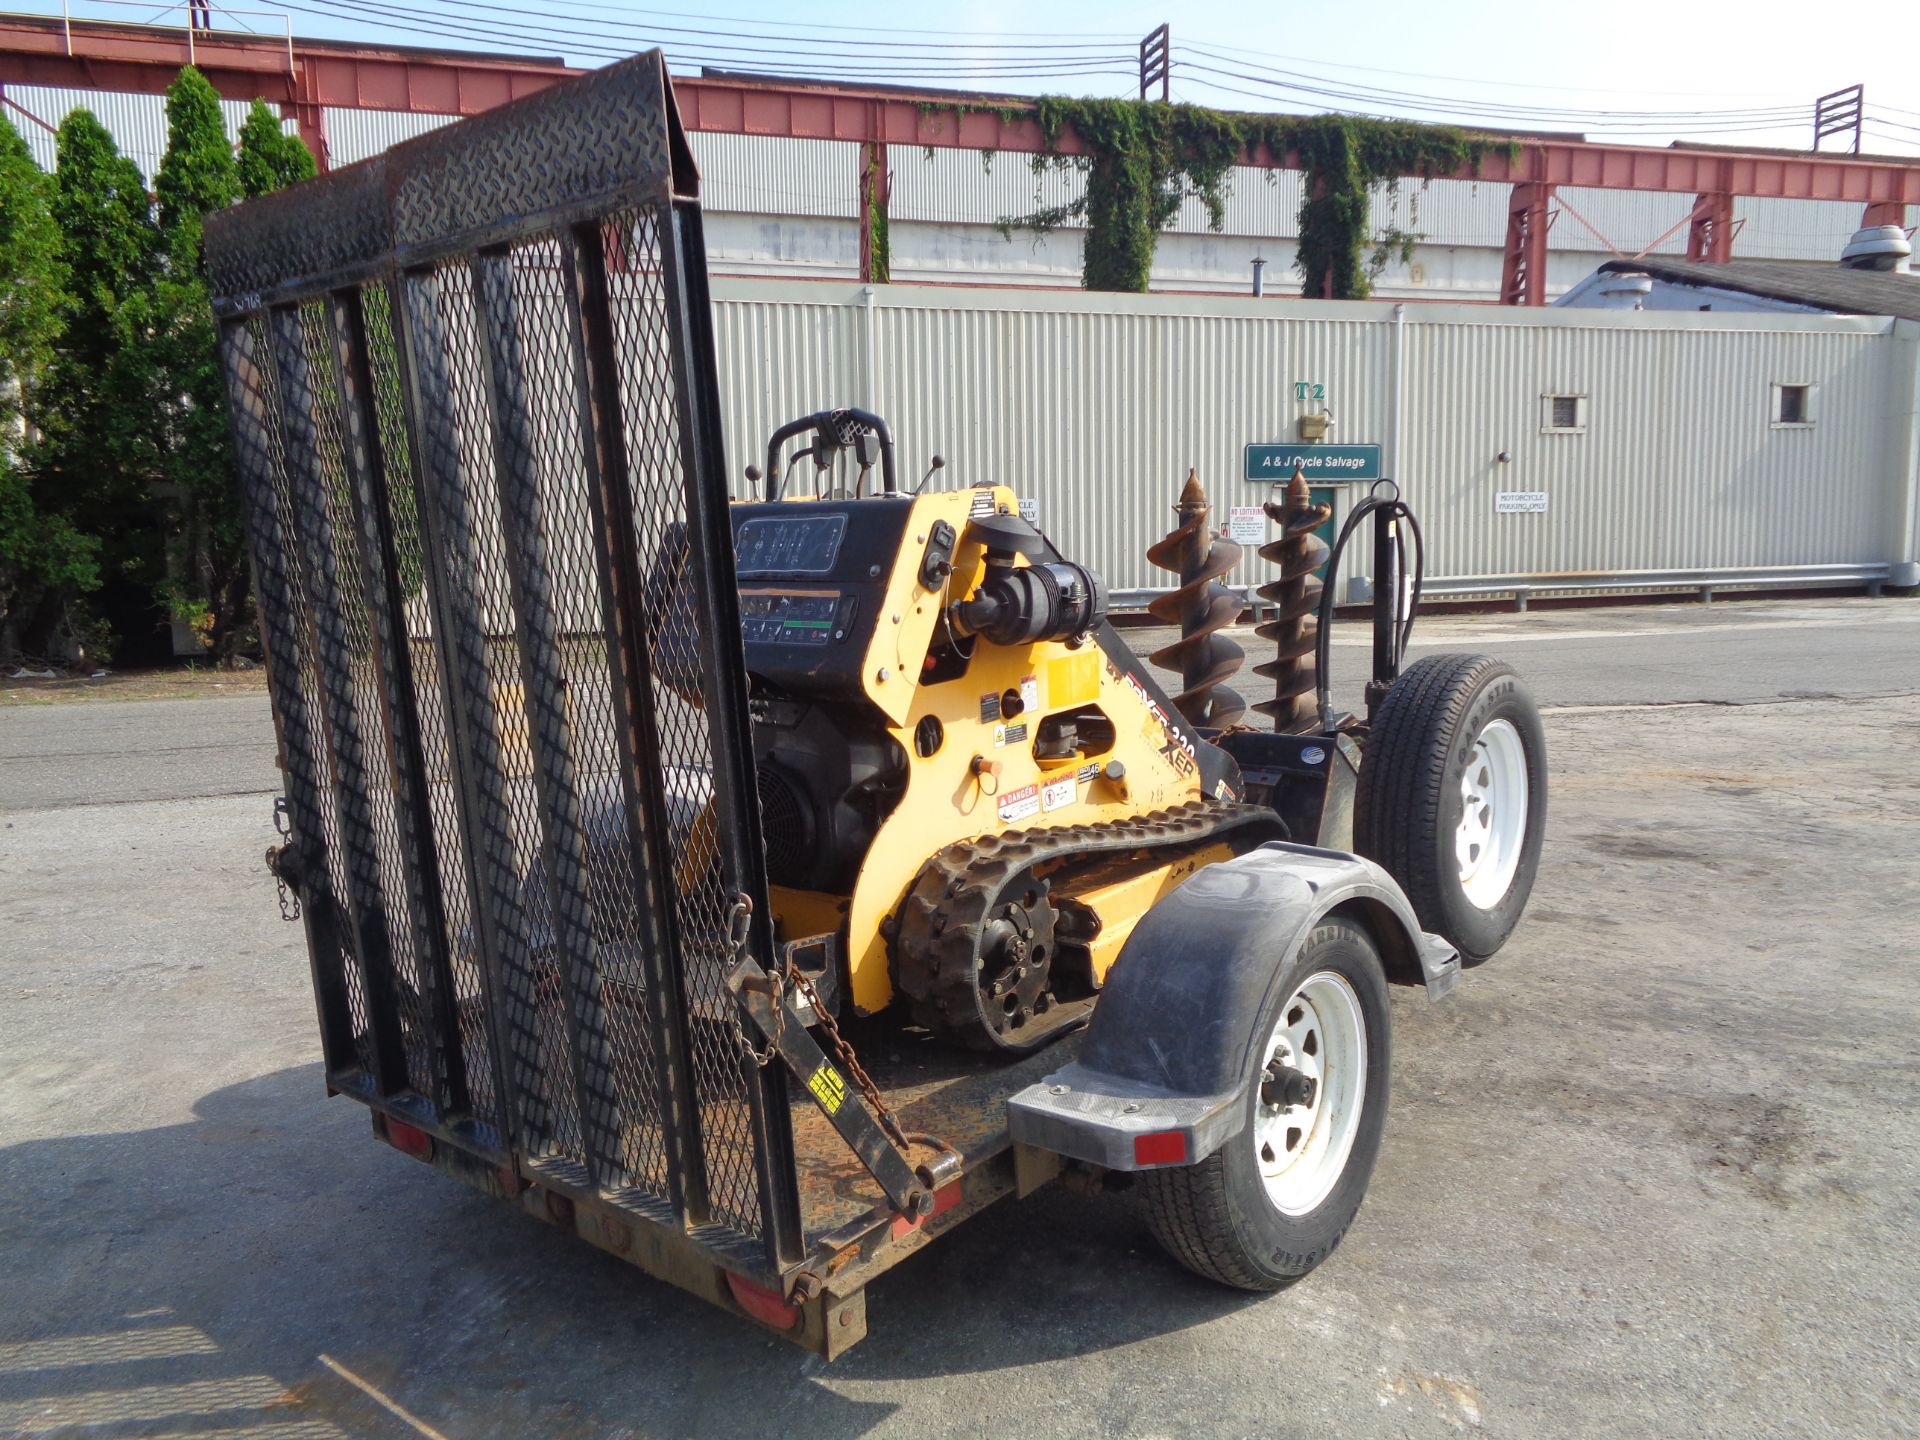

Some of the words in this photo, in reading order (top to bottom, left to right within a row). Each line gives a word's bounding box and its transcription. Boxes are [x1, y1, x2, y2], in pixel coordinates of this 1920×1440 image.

[1295, 381, 1325, 400] T2
[1262, 456, 1271, 467] A
[1273, 456, 1284, 467] &
[1284, 456, 1291, 467] J
[1293, 455, 1323, 470] Cycle
[1325, 456, 1366, 470] Salvage
[1008, 785, 1036, 803] DANGER!
